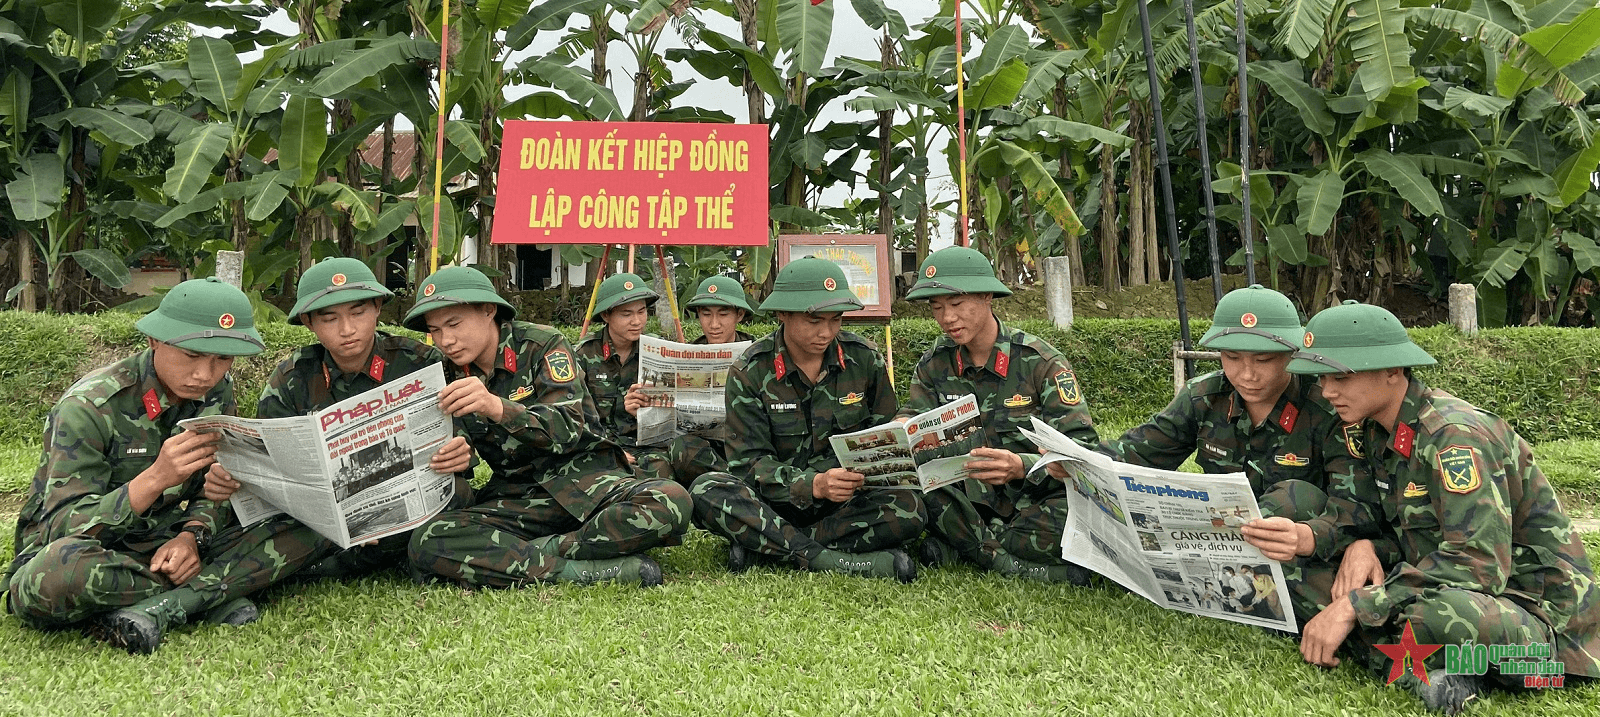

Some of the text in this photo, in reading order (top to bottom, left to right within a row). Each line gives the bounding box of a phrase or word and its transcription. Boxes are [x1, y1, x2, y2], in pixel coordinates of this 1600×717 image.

[520, 128, 749, 178] ĐOÀN KẾT HIỆP ĐỒNG
[528, 183, 736, 237] LẬP CÔNG TẬP THỂ
[320, 398, 384, 431] Pháp
[384, 379, 427, 405] luật
[372, 405, 388, 415] VIỆT
[390, 397, 409, 409] NAM
[941, 407, 955, 424] QUỐC
[1175, 541, 1189, 551] giá
[1208, 542, 1228, 552] dịch
[1229, 545, 1243, 553] vụ
